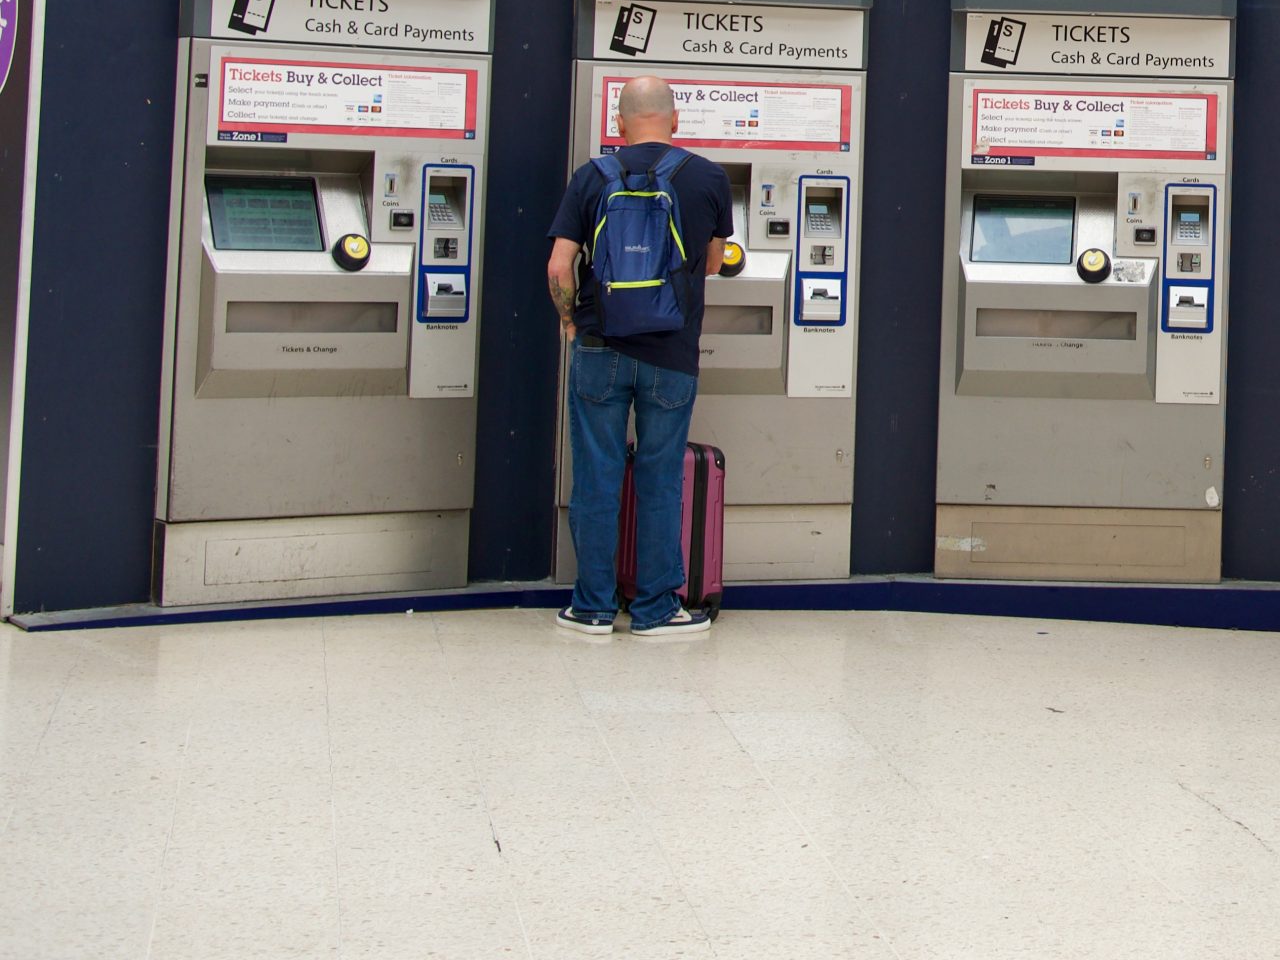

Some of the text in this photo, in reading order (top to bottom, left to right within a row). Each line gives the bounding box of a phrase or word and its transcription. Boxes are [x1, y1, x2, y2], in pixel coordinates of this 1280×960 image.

[683, 12, 764, 33] TICKETS
[304, 18, 474, 43] Cash & Card Payments
[1052, 25, 1130, 43] TICKETS
[682, 39, 848, 60] Cash & Card Payments
[1051, 51, 1214, 69] Cash & Card Payments
[229, 68, 382, 87] Tickets Buy & Collect
[228, 86, 253, 94] Select
[673, 90, 758, 103] uy & Collect
[254, 101, 290, 109] payment
[982, 98, 1124, 113] Tickets Buy & Collect
[228, 111, 256, 119] Collect
[232, 132, 256, 140] Zone
[1004, 126, 1038, 134] payment
[984, 156, 1006, 164] Zone
[313, 346, 337, 354] Change
